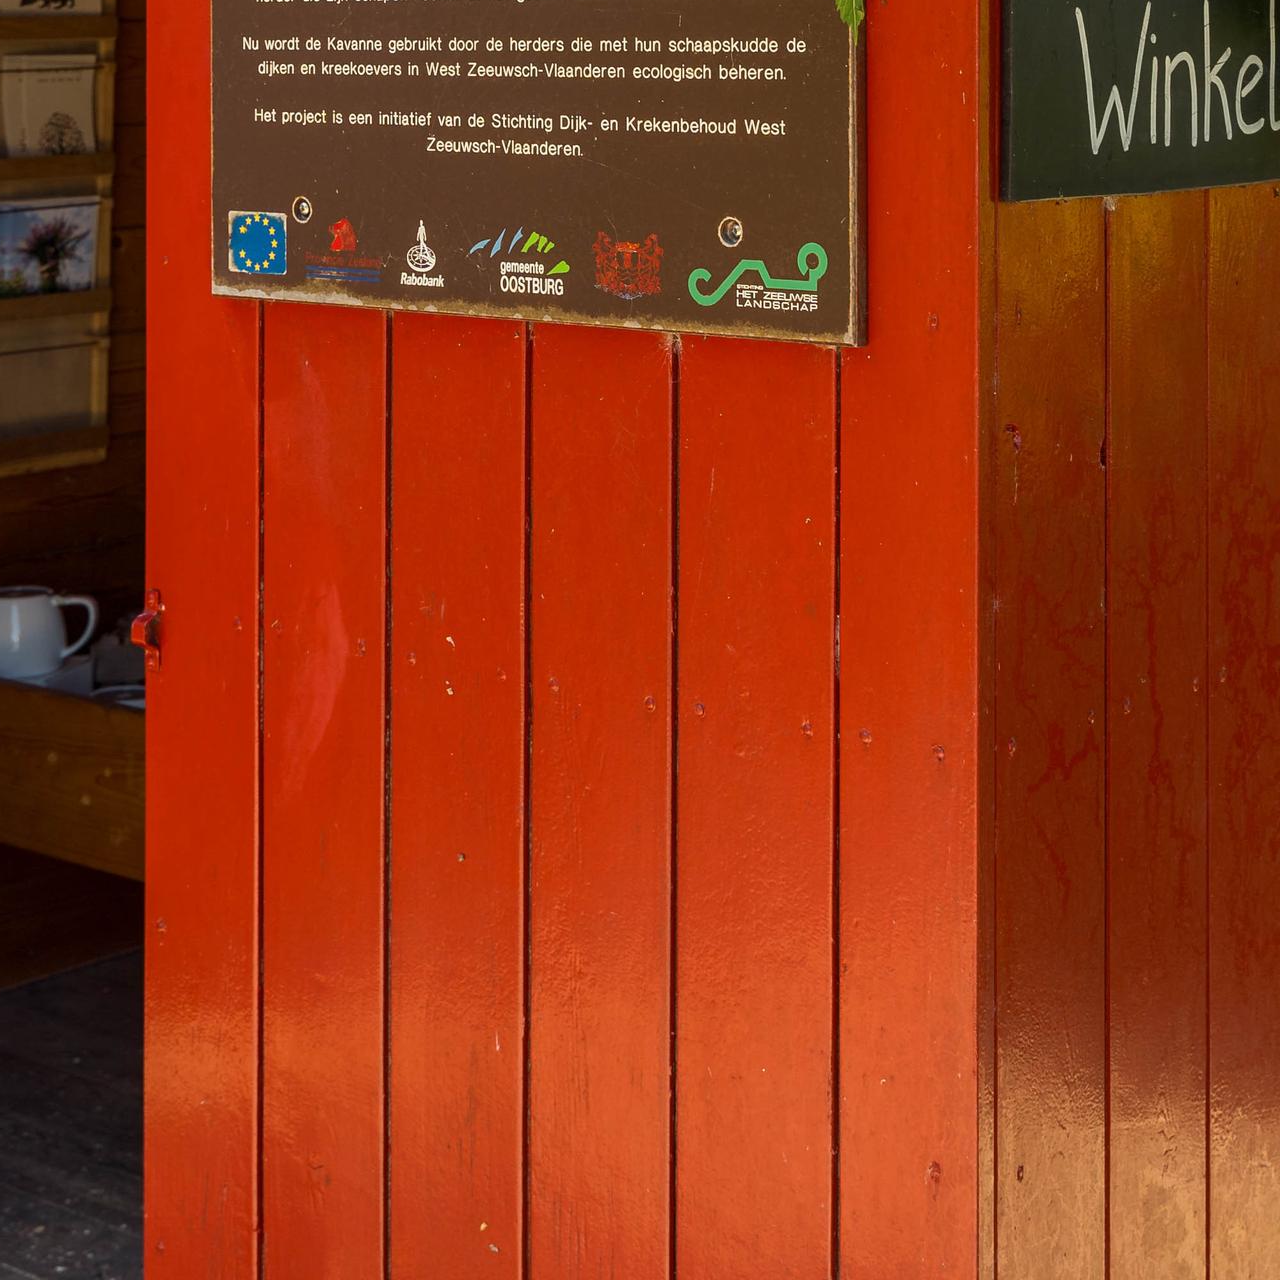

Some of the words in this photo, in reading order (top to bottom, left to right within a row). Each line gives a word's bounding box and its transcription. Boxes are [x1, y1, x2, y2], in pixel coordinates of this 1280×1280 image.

[242, 36, 260, 51] Nu
[264, 36, 300, 51] wordt
[305, 36, 322, 51] de
[327, 36, 383, 52] Kavanne
[387, 36, 443, 54] gebruikt
[448, 36, 480, 52] door
[485, 36, 504, 52] de
[509, 36, 565, 52] herders
[570, 36, 593, 53] die
[599, 36, 628, 53] met
[634, 36, 662, 53] hun
[668, 36, 779, 55] schaapskudde
[786, 36, 807, 53] de
[257, 60, 295, 78] dijken
[300, 63, 316, 75] en
[321, 60, 402, 77] kreekoevers
[407, 64, 420, 77] in
[425, 61, 461, 77] West
[467, 61, 626, 79] Zeeuwsch-Vlaanderen
[632, 63, 712, 83] ecologisch
[718, 64, 787, 81] beheren.
[254, 107, 277, 123] Het
[281, 109, 327, 126] project
[332, 109, 344, 125] is
[348, 112, 373, 125] een
[378, 110, 432, 127] initiatief
[437, 115, 462, 128] van
[467, 112, 485, 128] de
[491, 113, 553, 133] Stichting
[559, 114, 593, 134] Dijk-
[600, 118, 619, 132] en
[625, 116, 737, 135] Krekenbehoud
[743, 118, 786, 136] West
[426, 137, 584, 157] Zeeuwsch-Vlaanderen.
[499, 260, 545, 275] gemeente
[400, 271, 445, 288] Rabobank
[499, 275, 565, 296] OOSTBURG
[736, 289, 759, 299] HET
[762, 291, 818, 304] ZEEUWSE
[736, 299, 818, 313] LANDSCHAP
